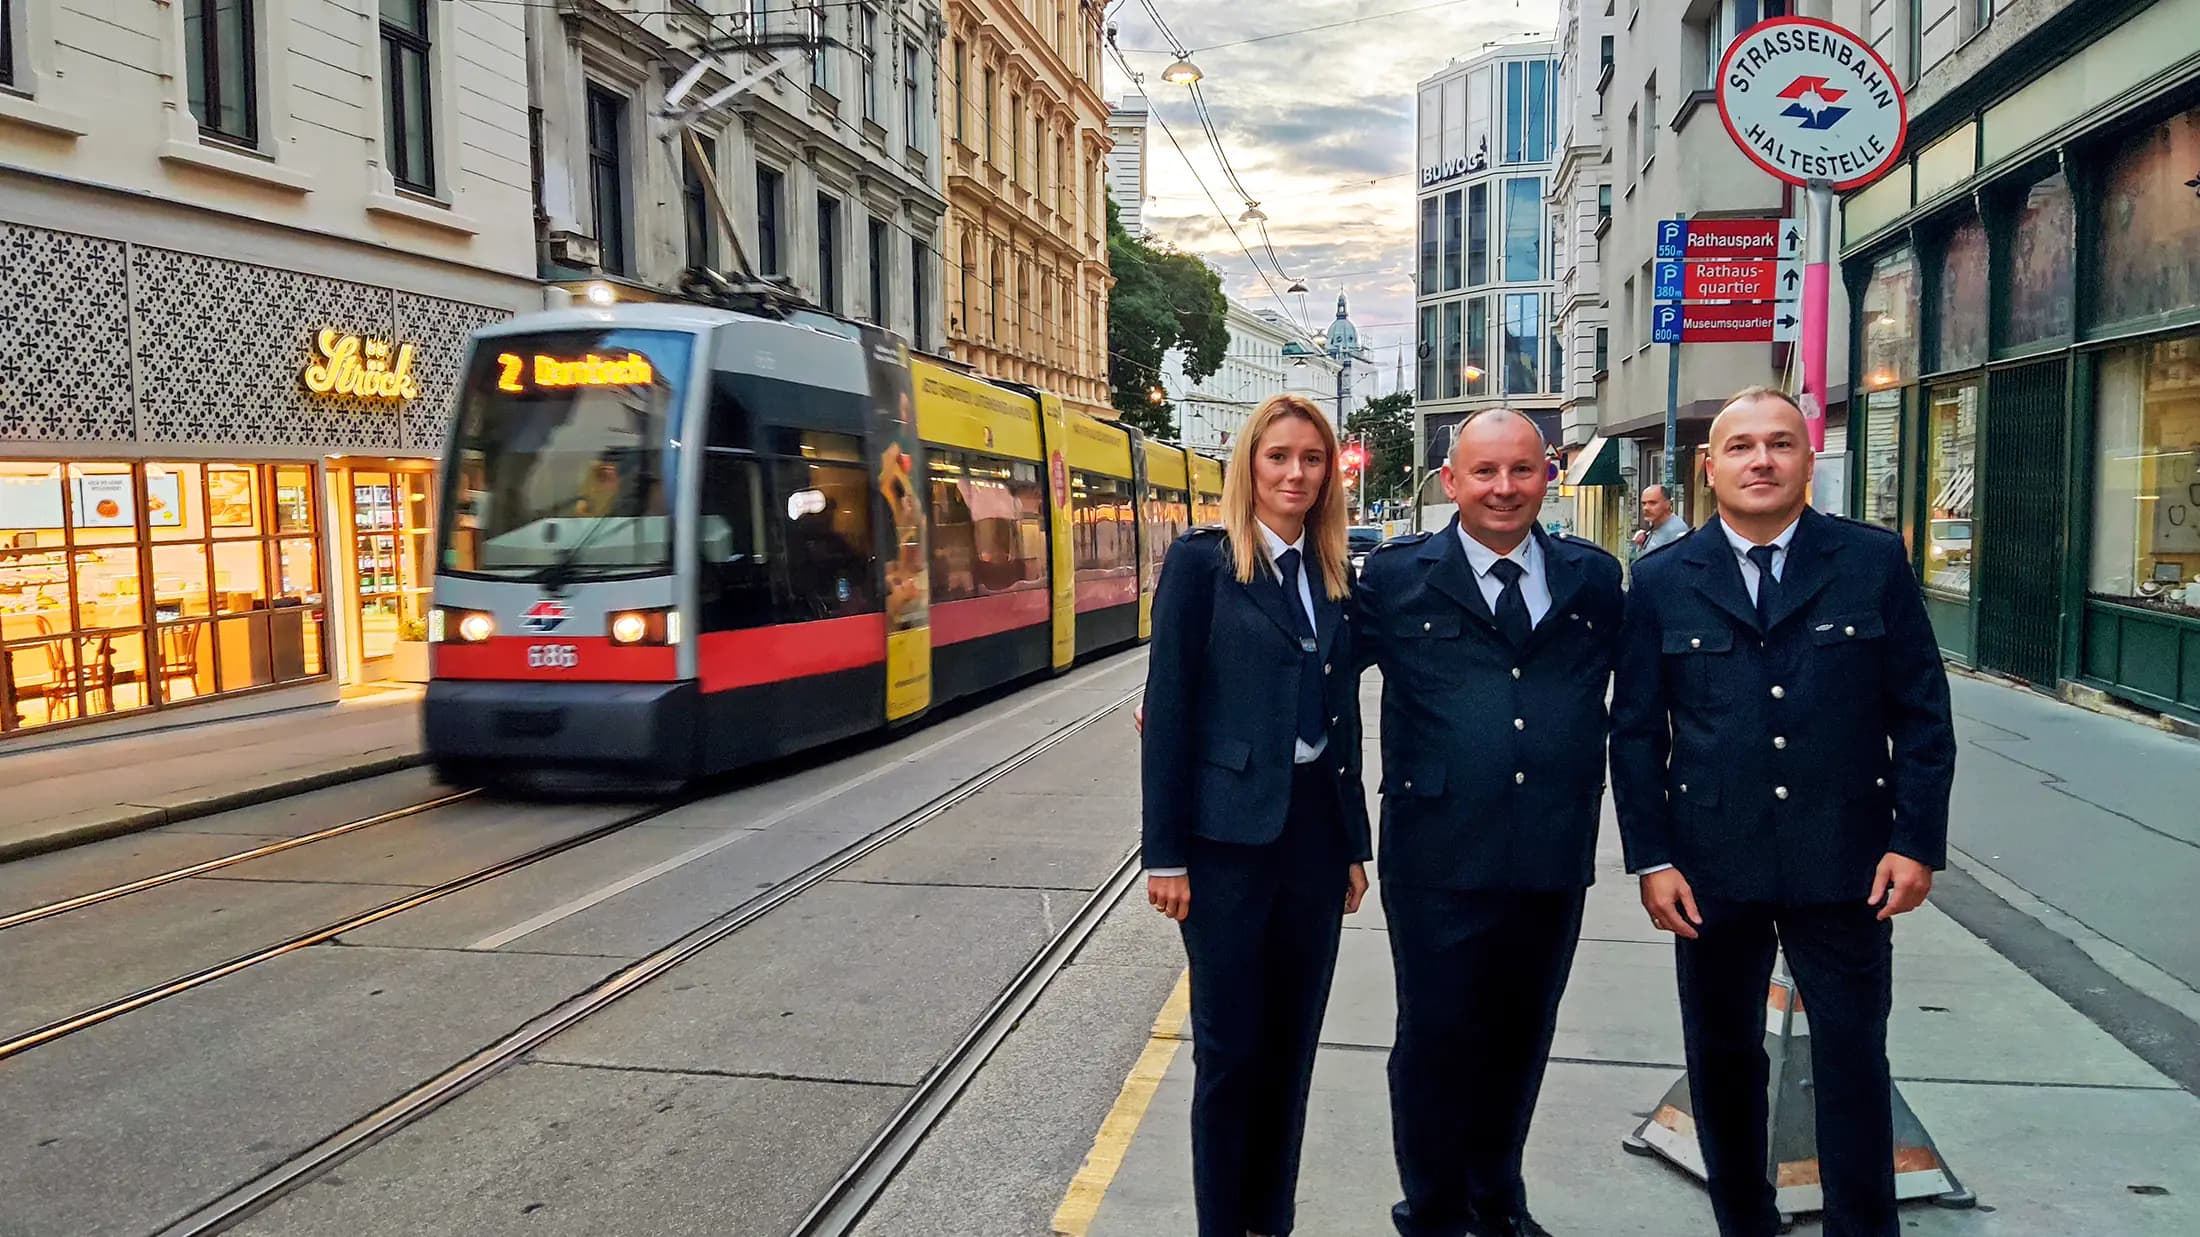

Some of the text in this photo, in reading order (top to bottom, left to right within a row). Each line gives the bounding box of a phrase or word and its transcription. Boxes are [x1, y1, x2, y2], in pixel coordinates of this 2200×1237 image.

[1730, 29, 1893, 109] STRASSENBAHN
[1748, 123, 1885, 176] HALTESTELLE
[1422, 152, 1478, 186] BUWOG
[1687, 232, 1774, 249] Rathauspark
[1696, 264, 1764, 277] Rathaus-
[1698, 280, 1760, 296] quartier
[1683, 317, 1773, 330] Museumsquartier
[304, 327, 418, 400] Ströck
[497, 352, 524, 391] 2
[528, 644, 579, 668] 686
